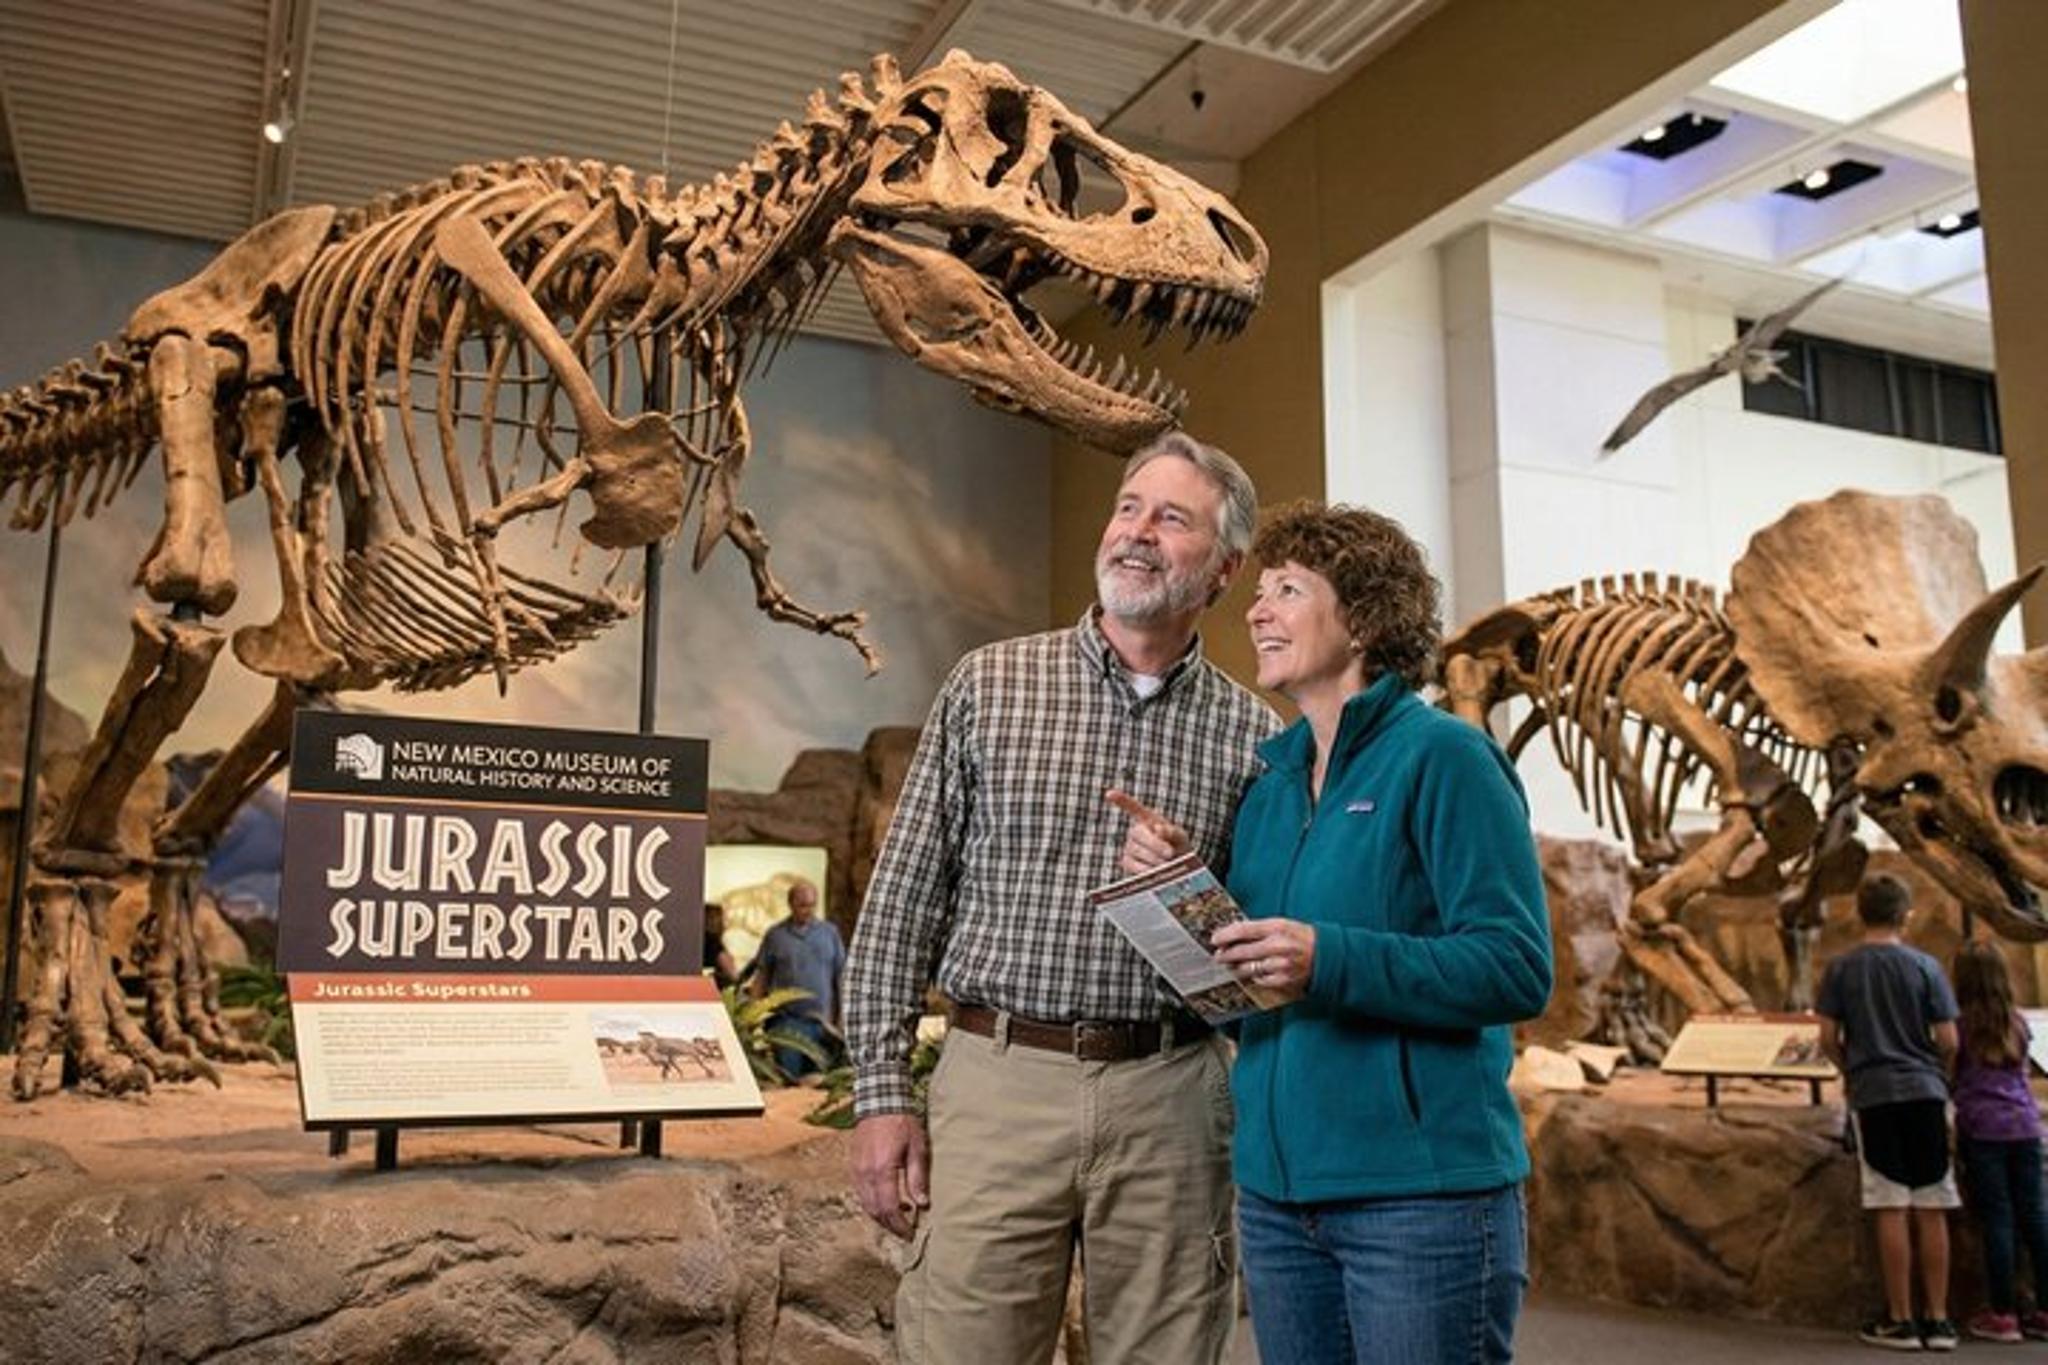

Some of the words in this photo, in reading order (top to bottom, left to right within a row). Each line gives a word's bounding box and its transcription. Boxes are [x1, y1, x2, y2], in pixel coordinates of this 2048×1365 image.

[392, 741, 446, 763] NEW
[452, 745, 538, 769] MEXICO
[544, 752, 638, 774] MUSEUM
[646, 758, 671, 777] OF
[392, 766, 475, 785] NATURAL
[480, 772, 553, 789] HISTORY
[557, 776, 597, 792] AND
[600, 779, 670, 796] SCIENCE
[327, 812, 671, 900] JURASSIC
[326, 899, 665, 963] SUPERSTARS
[313, 982, 405, 999] Jurassic
[412, 982, 531, 1000] Superstars
